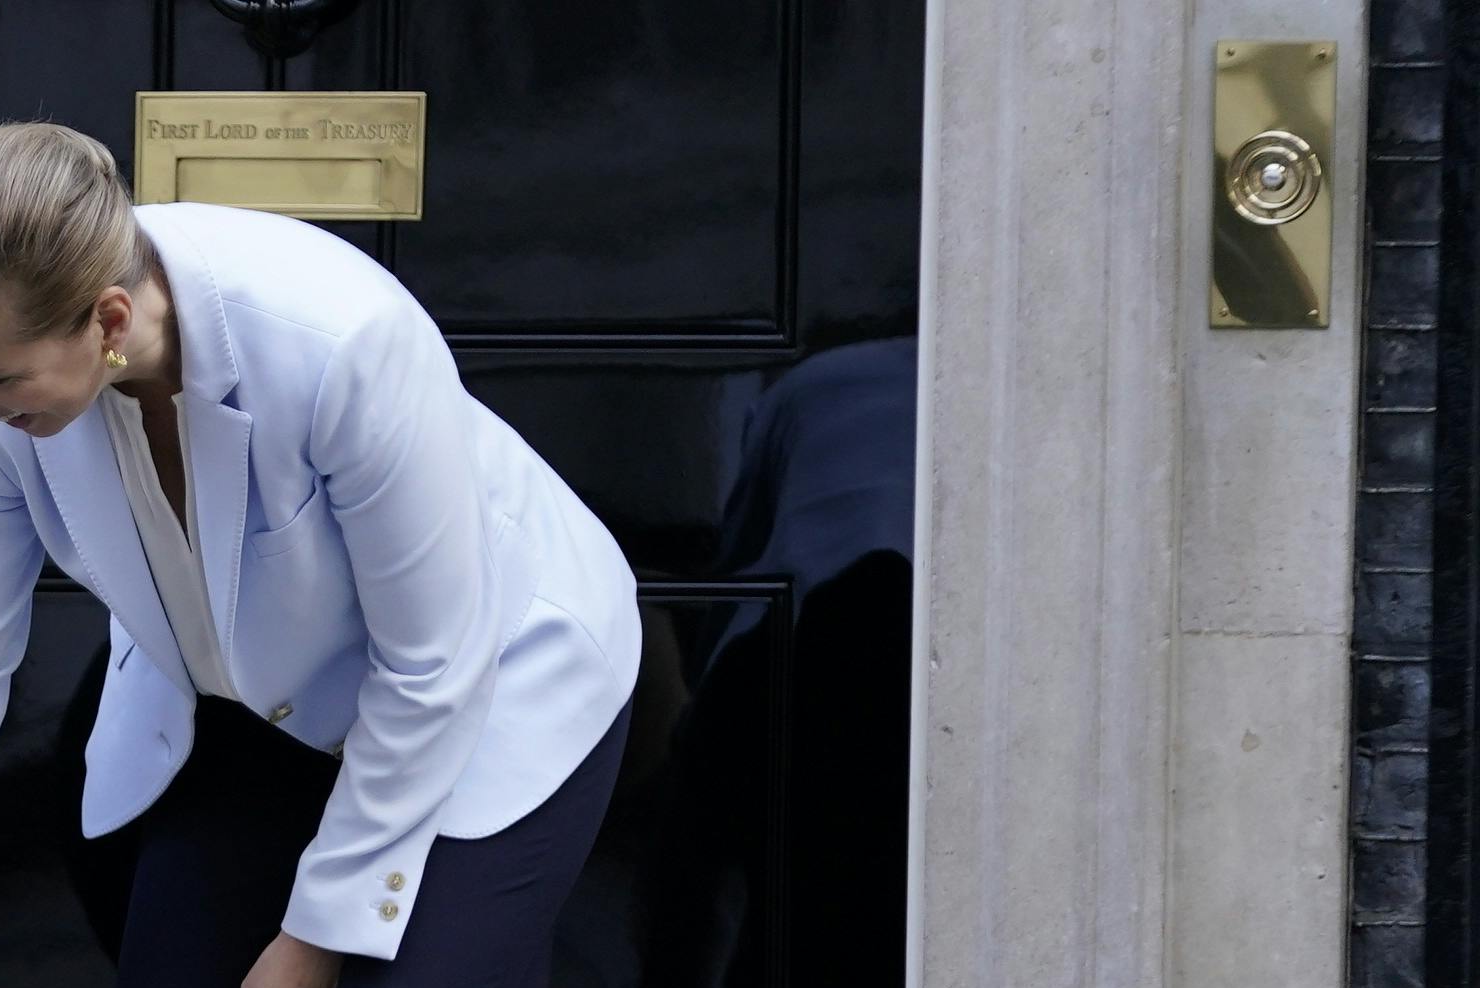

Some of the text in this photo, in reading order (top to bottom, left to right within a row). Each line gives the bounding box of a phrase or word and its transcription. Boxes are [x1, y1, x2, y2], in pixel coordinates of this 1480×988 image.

[146, 119, 199, 140] FIRST
[204, 119, 258, 139] LORD
[317, 118, 412, 140] TREASURY
